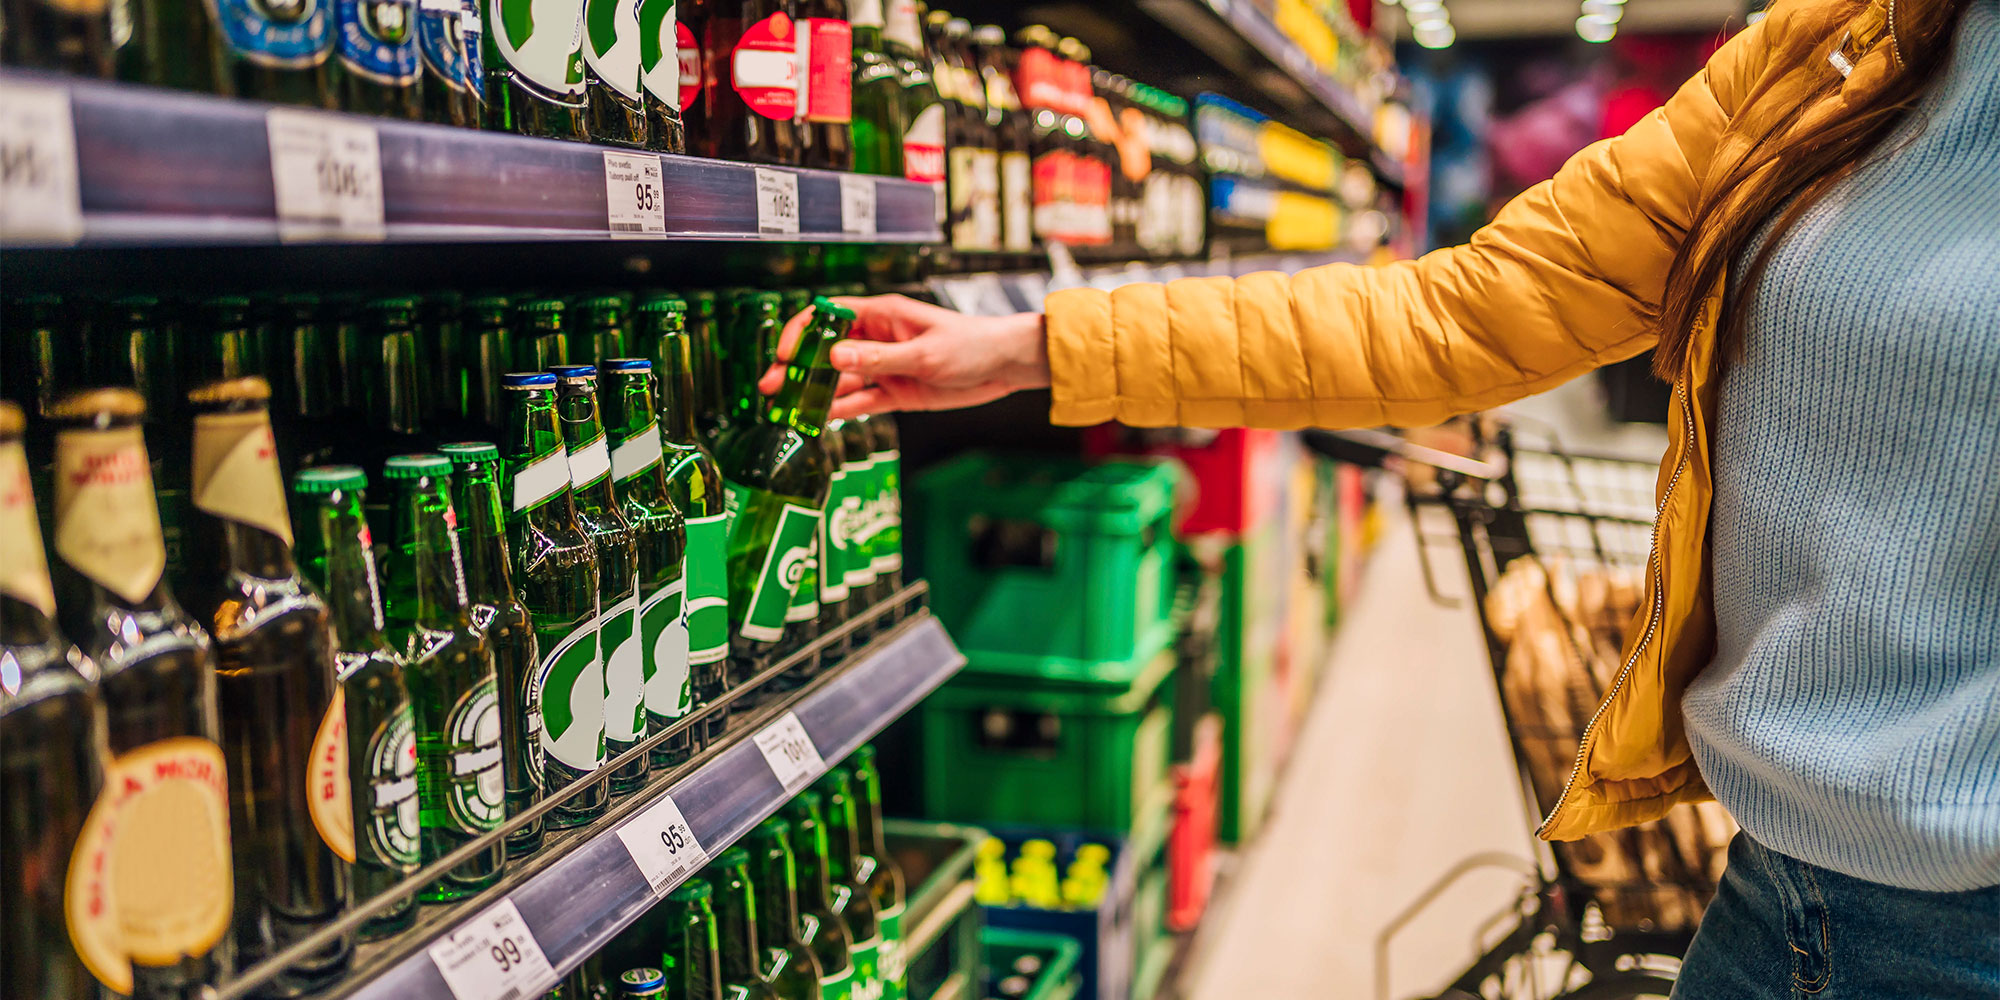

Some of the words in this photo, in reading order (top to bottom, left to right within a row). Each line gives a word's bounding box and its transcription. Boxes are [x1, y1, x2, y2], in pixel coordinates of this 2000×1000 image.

[636, 183, 653, 211] 95
[661, 823, 685, 855] 95
[491, 937, 521, 973] 99
